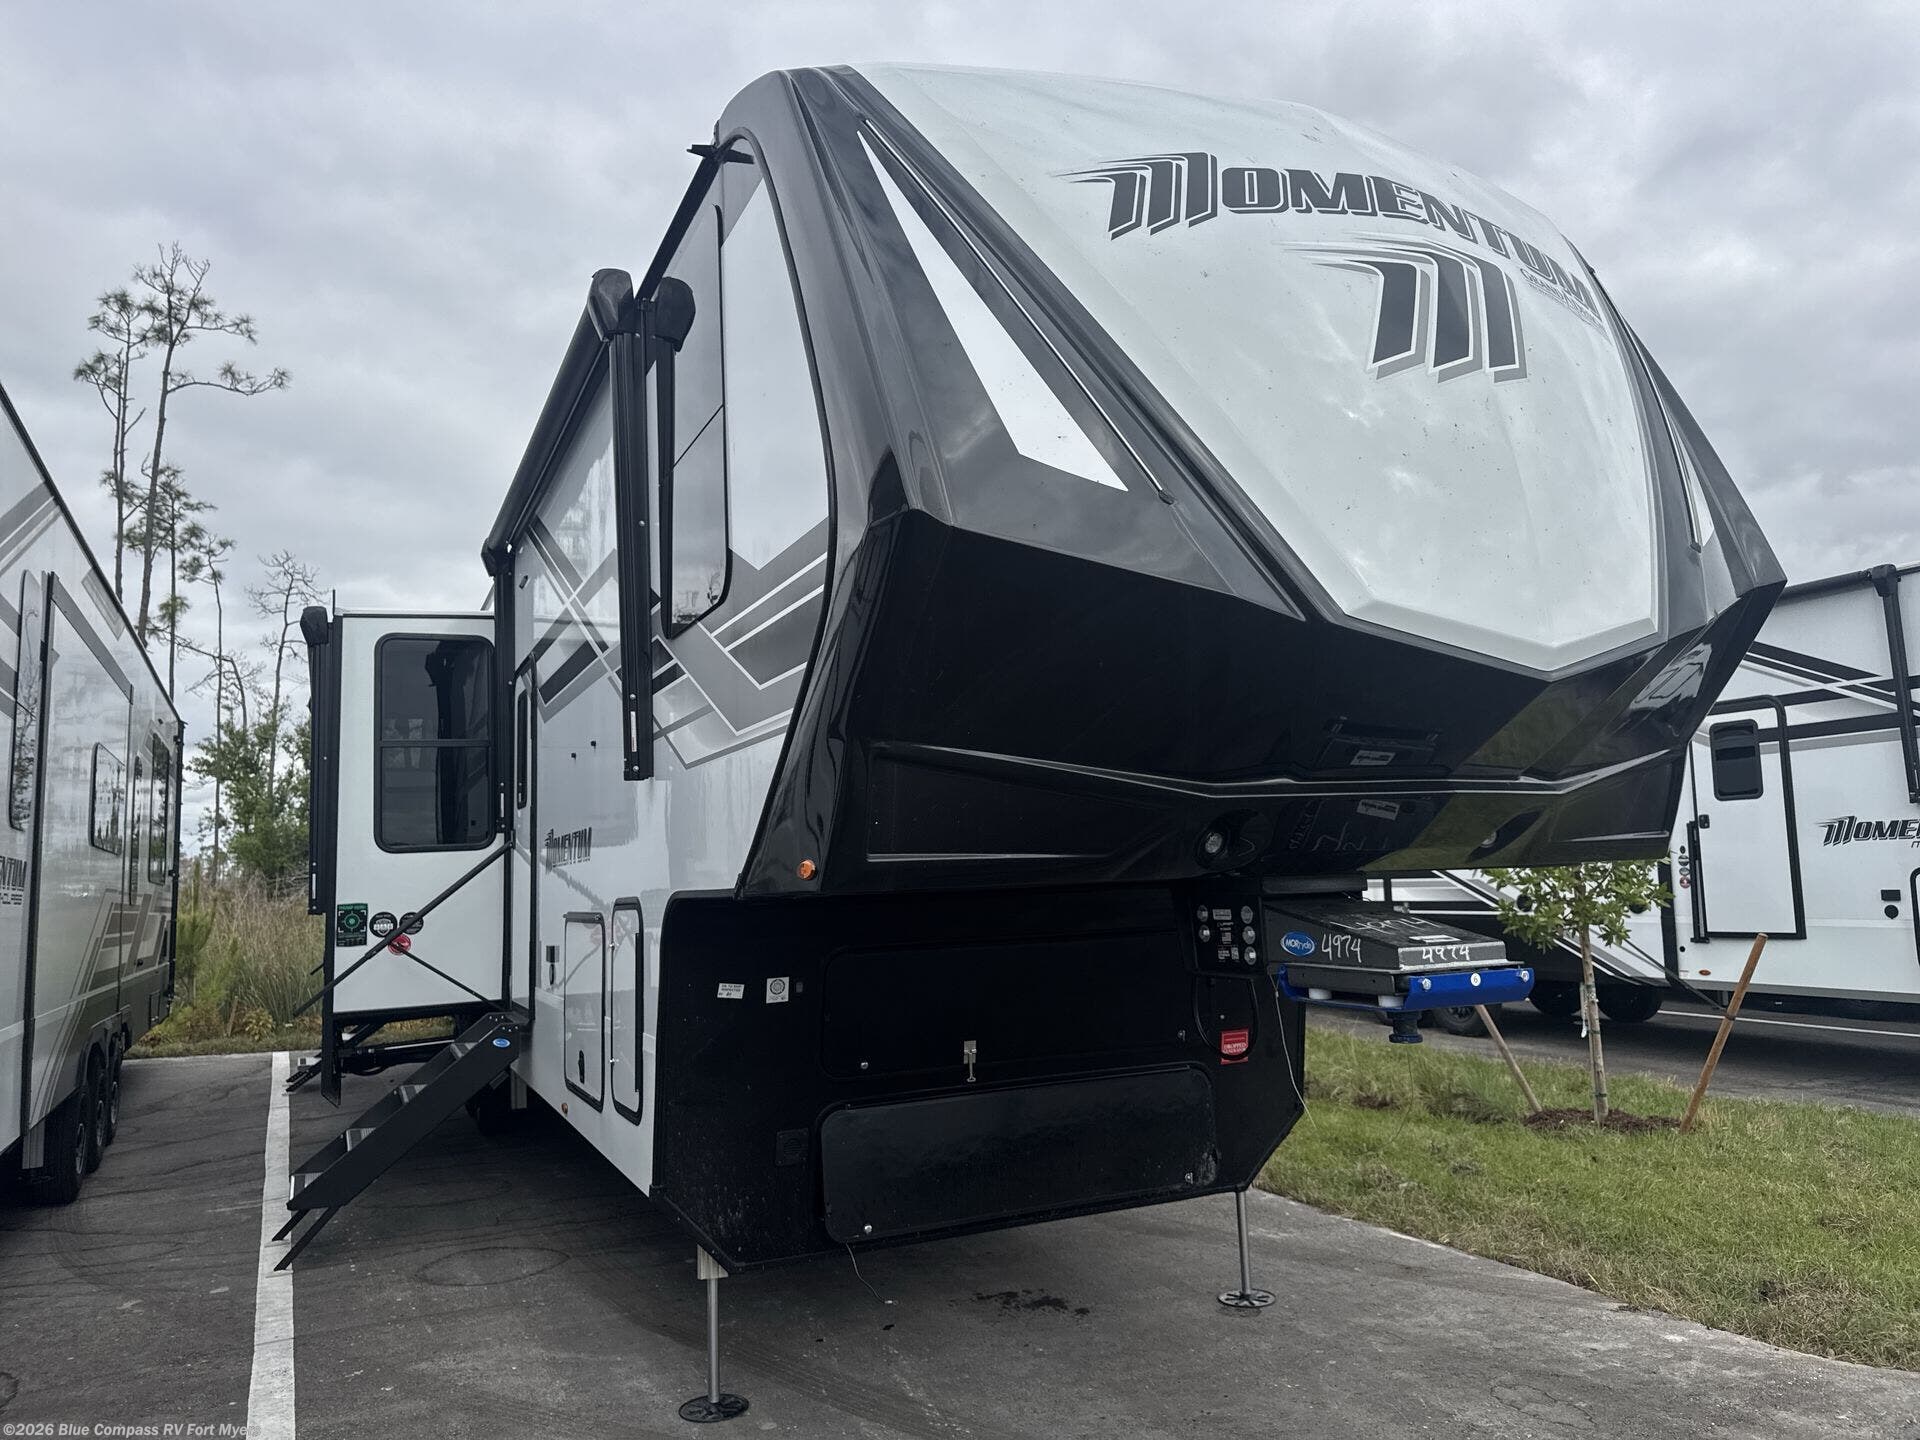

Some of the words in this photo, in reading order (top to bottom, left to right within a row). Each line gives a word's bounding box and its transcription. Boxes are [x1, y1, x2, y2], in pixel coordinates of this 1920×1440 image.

[1050, 152, 1602, 321] MOMENTUM
[1812, 815, 1920, 846] MOME
[1321, 932, 1362, 963] 4974
[1422, 944, 1470, 963] 4974
